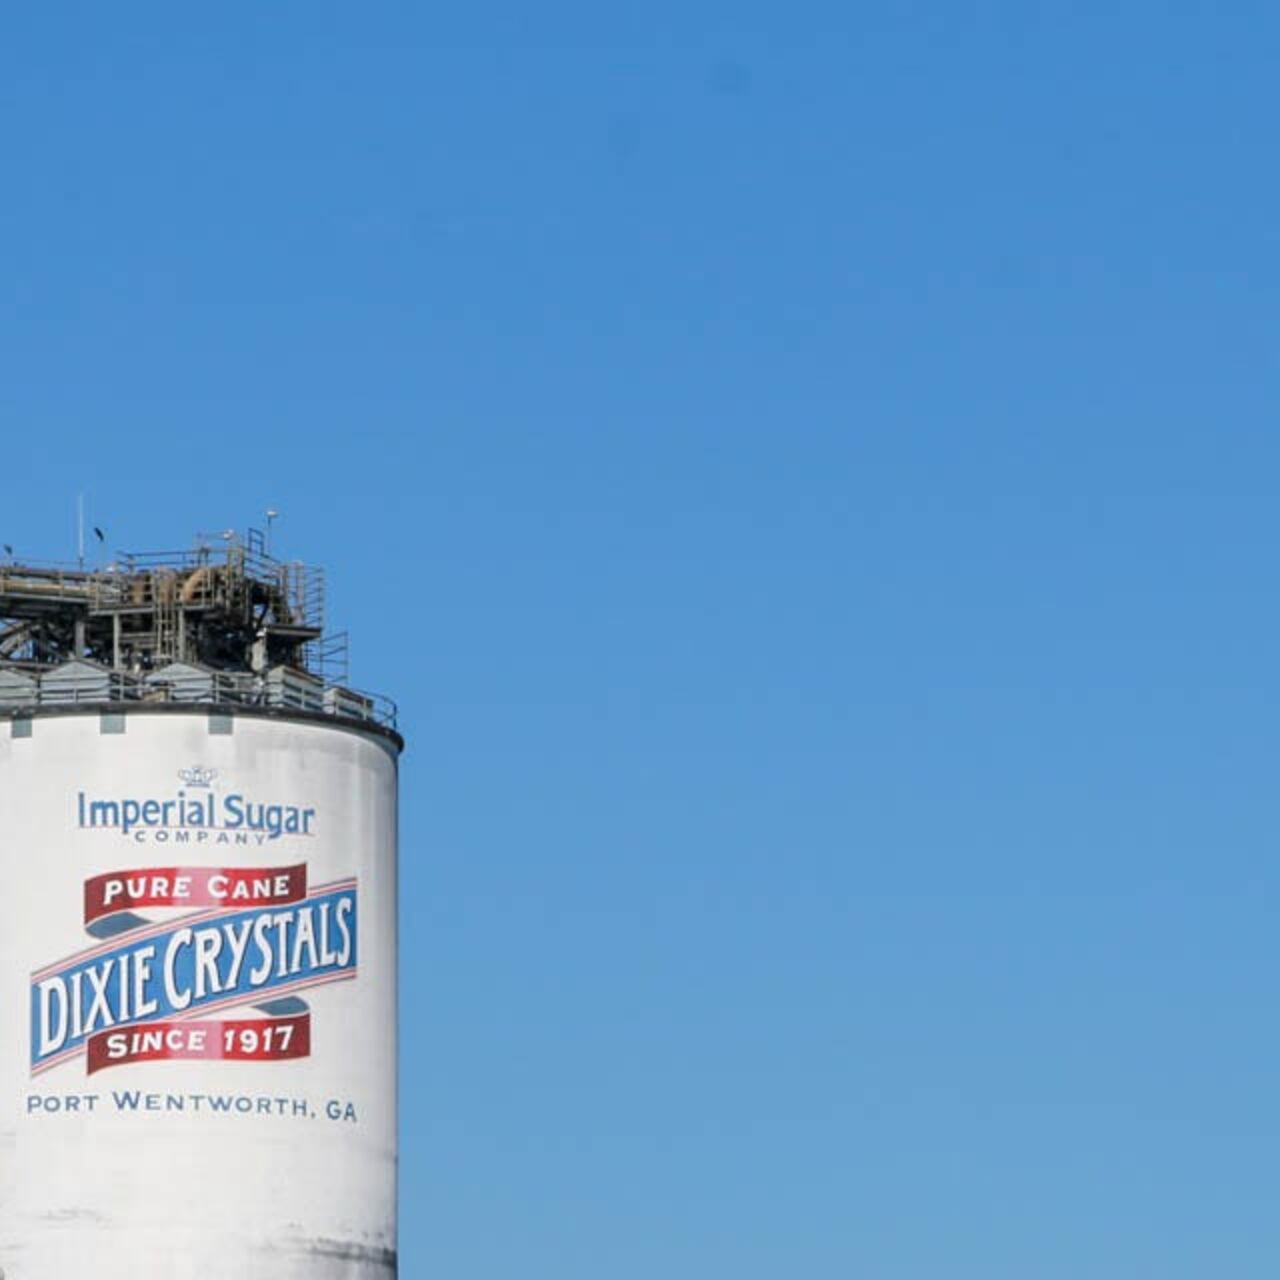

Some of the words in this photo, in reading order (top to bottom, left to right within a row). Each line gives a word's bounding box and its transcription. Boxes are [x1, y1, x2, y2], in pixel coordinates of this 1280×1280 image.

[78, 791, 215, 834] Imperial
[223, 794, 316, 839] Sugar
[134, 830, 268, 846] COMPANY
[103, 876, 192, 905] PURE
[207, 874, 291, 899] CANE
[36, 944, 160, 1058] DIXIE
[163, 896, 354, 1010] CRYSTALS
[106, 1029, 207, 1058] SINCE
[224, 1024, 295, 1053] 1917
[26, 1094, 100, 1114] PORT
[113, 1091, 317, 1119] WENTWORTH,
[326, 1099, 358, 1122] GA
